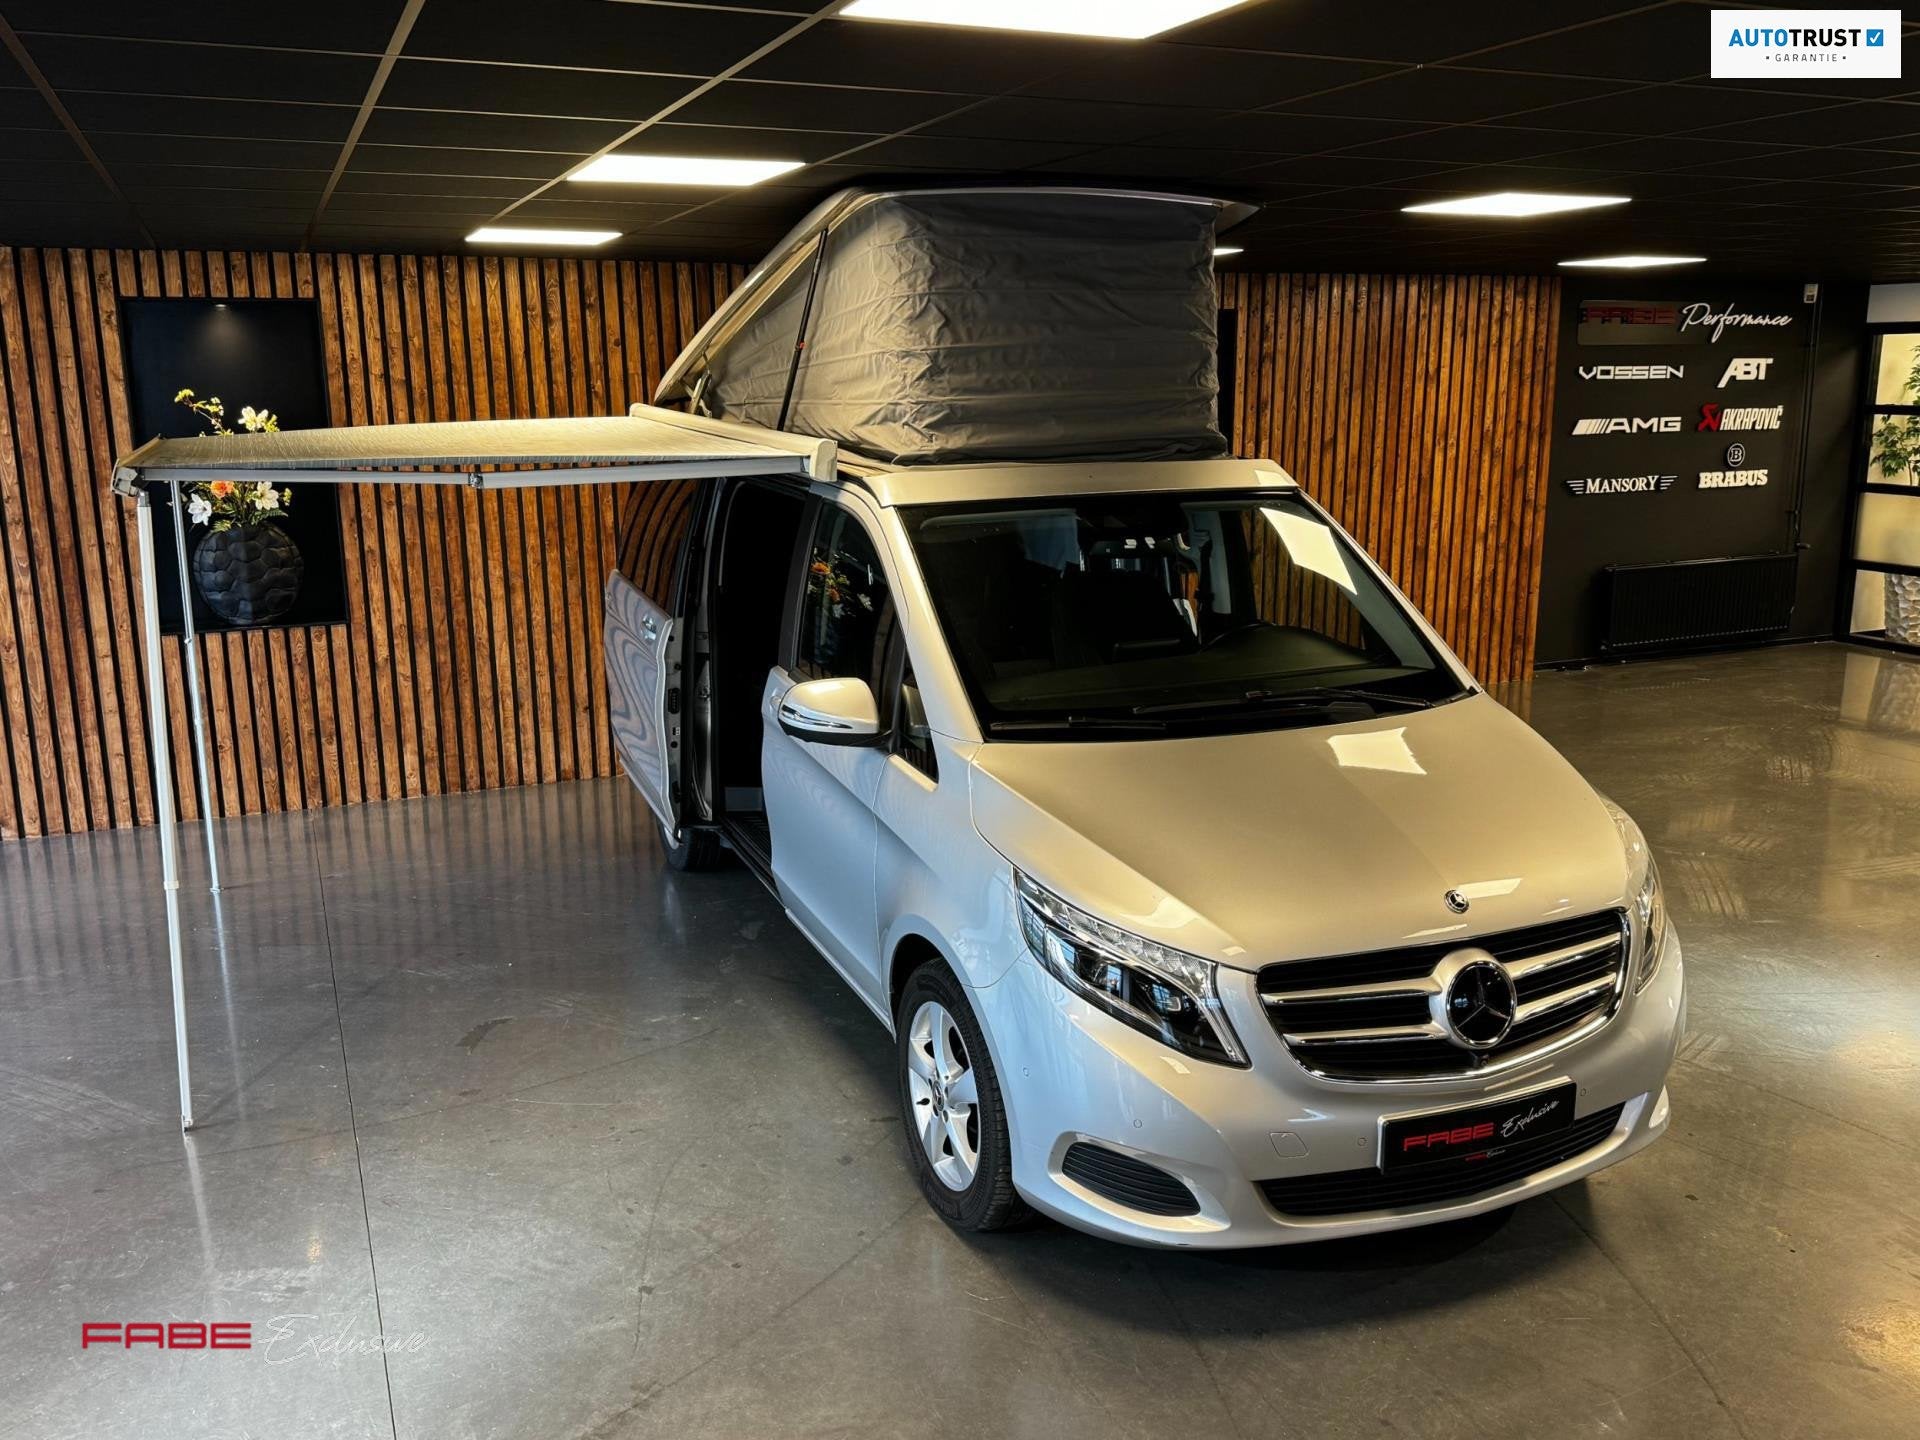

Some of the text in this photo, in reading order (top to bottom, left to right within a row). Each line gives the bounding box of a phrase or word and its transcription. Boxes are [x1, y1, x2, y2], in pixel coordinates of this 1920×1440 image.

[1680, 302, 1792, 343] Performance
[1579, 364, 1684, 380] VOSSEN
[1717, 357, 1774, 388] ABT
[1698, 469, 1768, 489] BRABUS
[1403, 1099, 1559, 1152] FABE Exclusive
